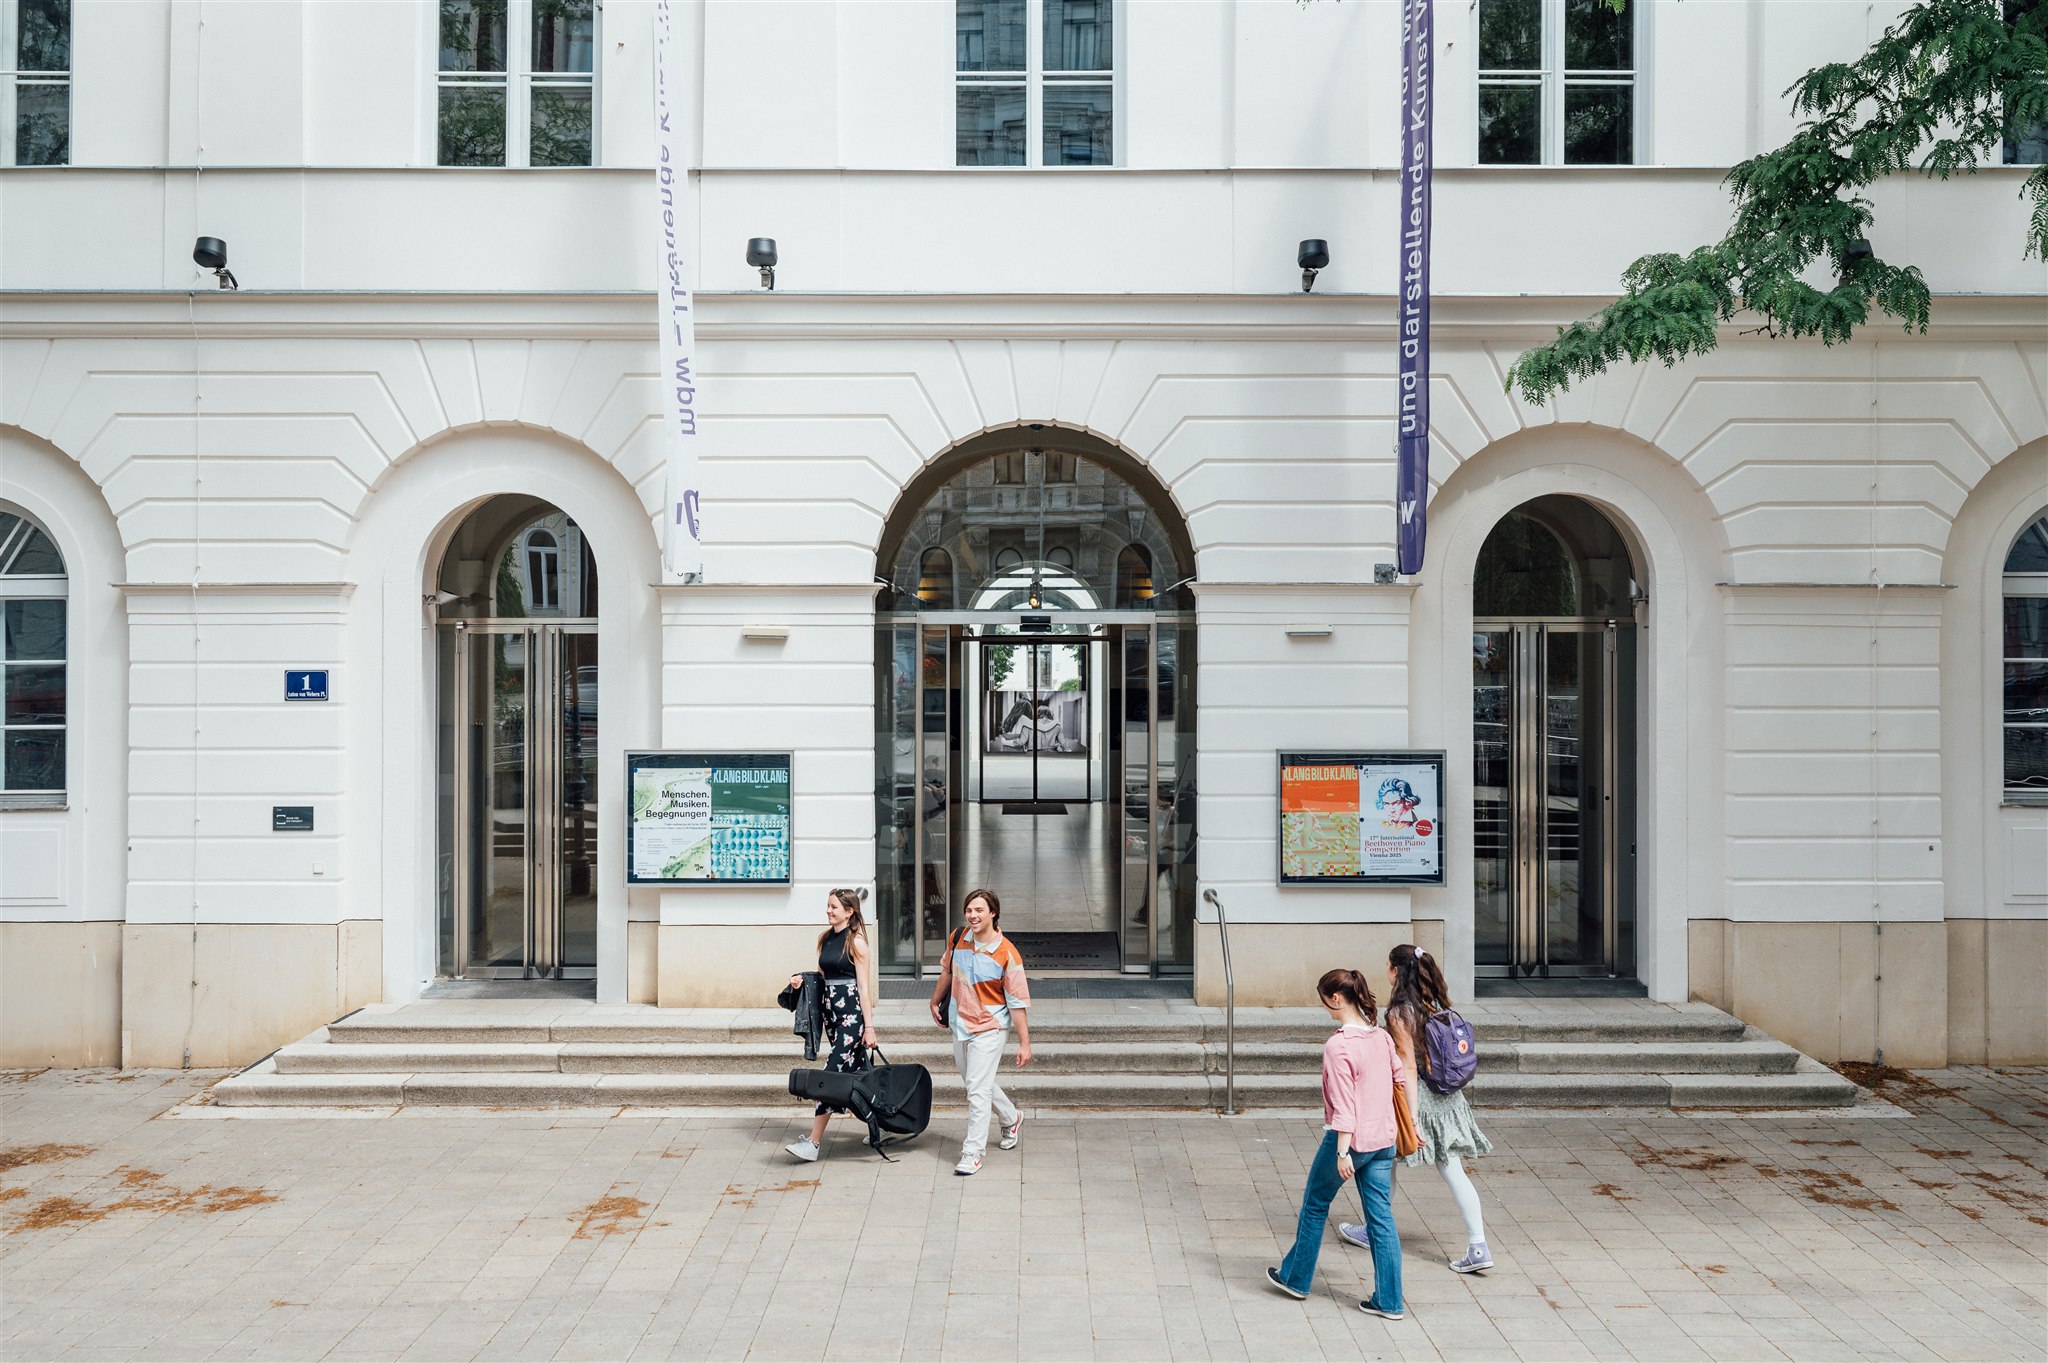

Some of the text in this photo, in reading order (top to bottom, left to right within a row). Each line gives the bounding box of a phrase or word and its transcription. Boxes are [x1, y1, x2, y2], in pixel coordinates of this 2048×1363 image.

[1411, 28, 1428, 131] Kunst
[1402, 141, 1424, 359] darstellende
[1401, 370, 1417, 433] und
[302, 674, 312, 691] 1
[662, 791, 710, 799] Menschen.
[671, 800, 710, 808] Musiken.
[646, 810, 707, 819] Begegnungen
